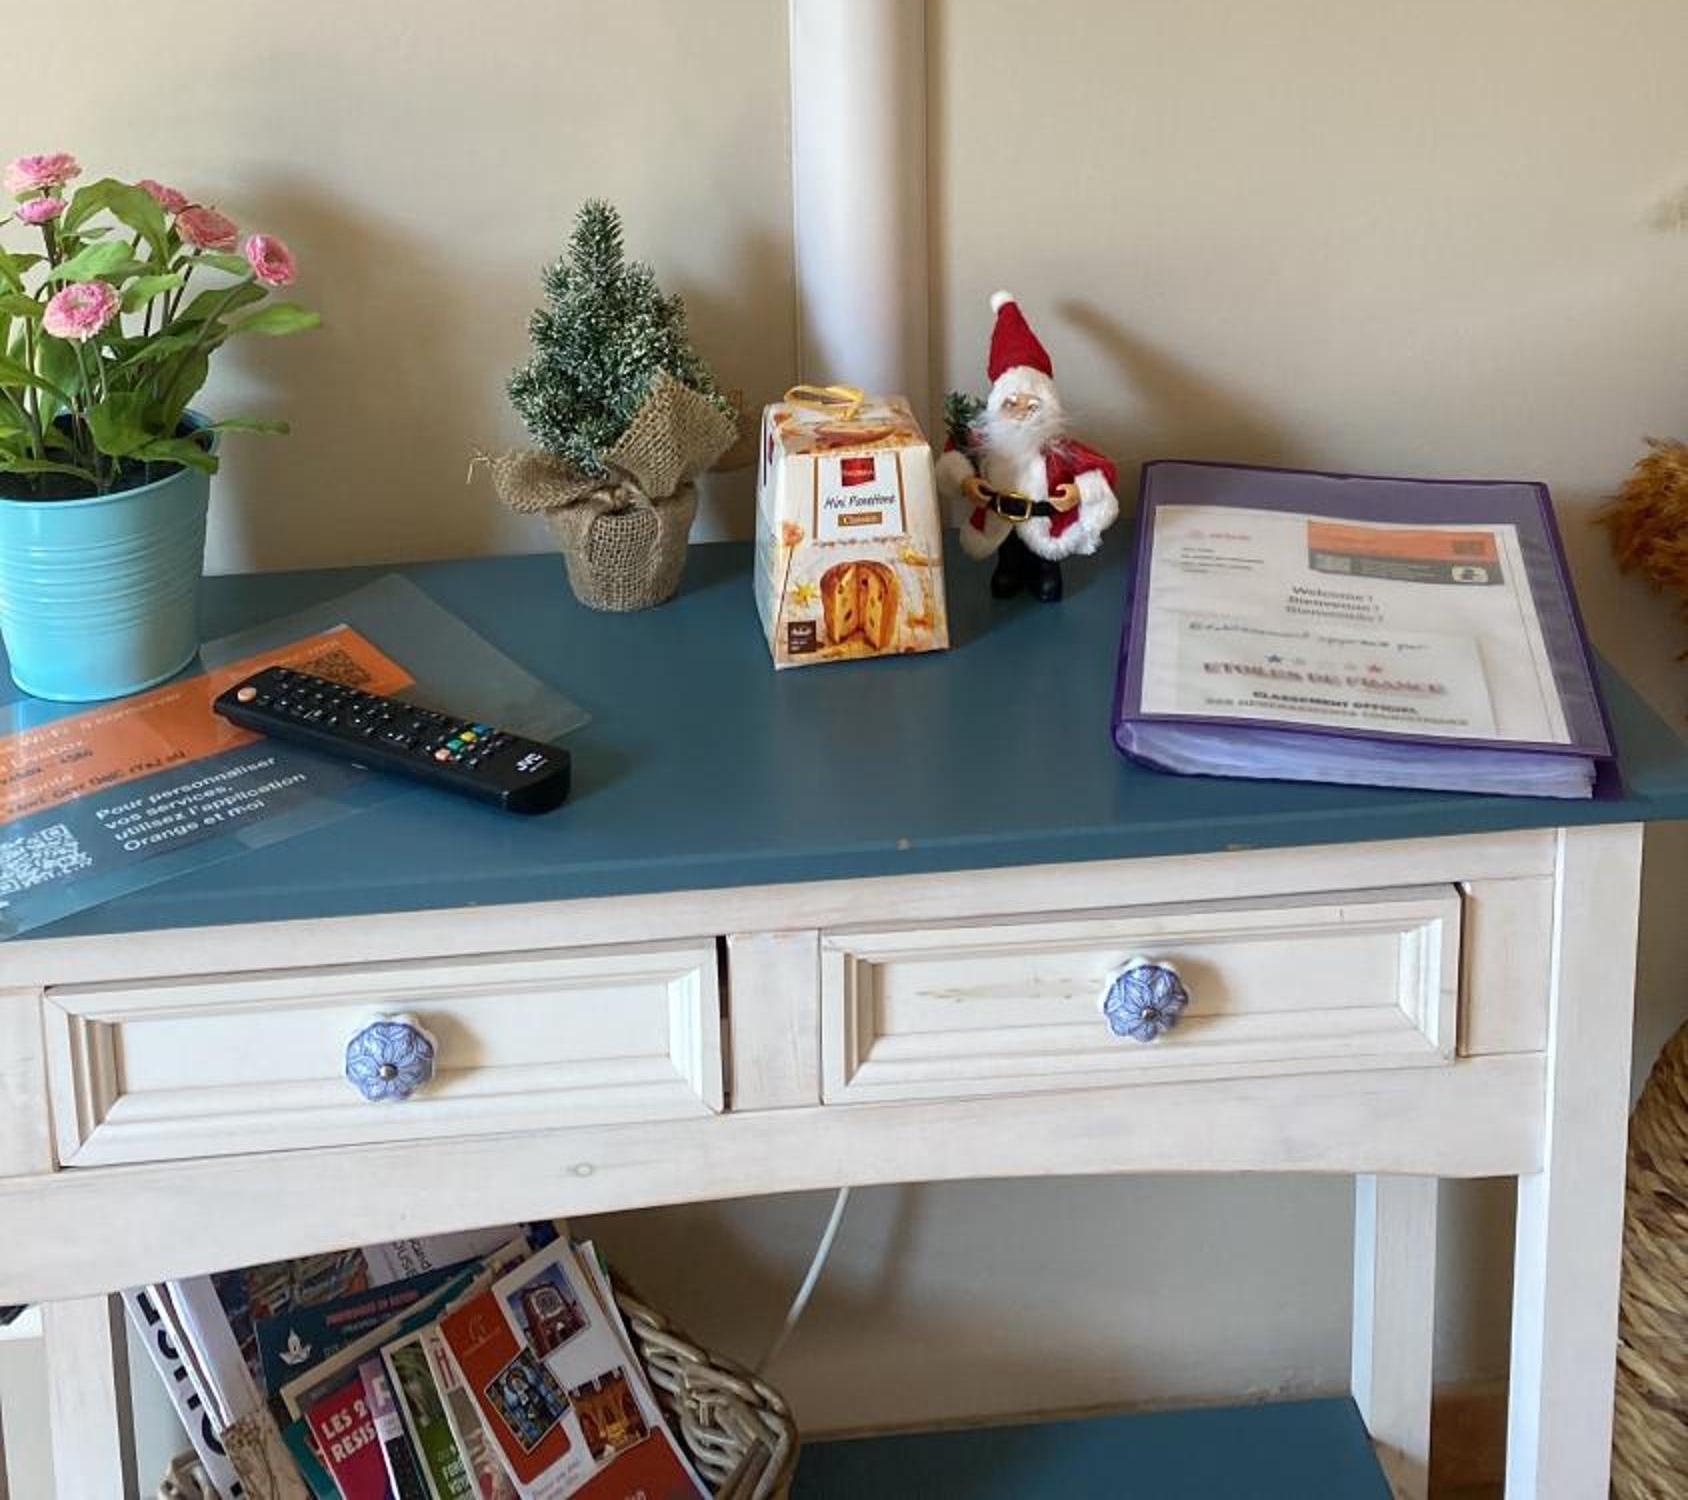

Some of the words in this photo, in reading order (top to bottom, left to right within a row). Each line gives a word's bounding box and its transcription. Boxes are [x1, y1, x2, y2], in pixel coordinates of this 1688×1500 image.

[96, 799, 143, 820] Pour
[149, 756, 275, 804] personnaliser
[114, 812, 186, 841] utilisez
[188, 773, 307, 816] l'application
[104, 813, 142, 830] vos
[123, 821, 200, 851] Orange
[203, 813, 225, 826] et
[228, 799, 265, 818] moi
[321, 1407, 352, 1440] LES
